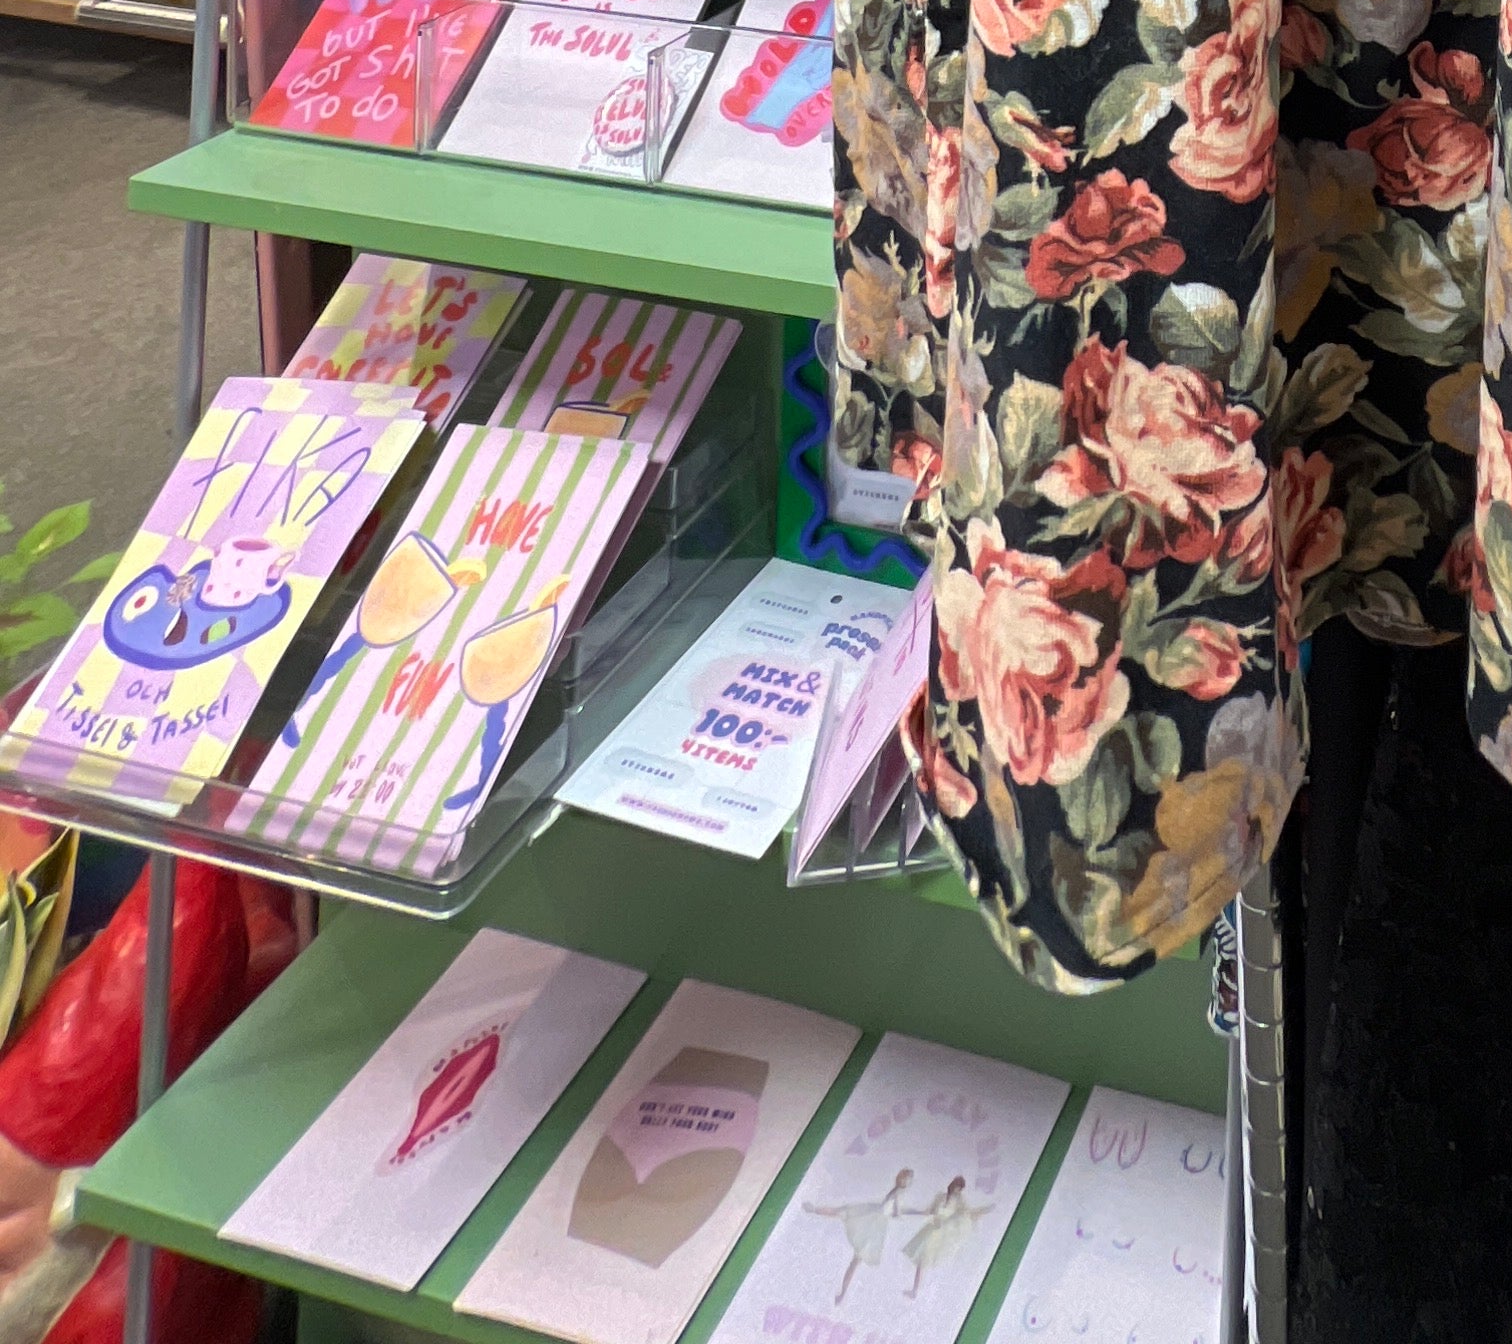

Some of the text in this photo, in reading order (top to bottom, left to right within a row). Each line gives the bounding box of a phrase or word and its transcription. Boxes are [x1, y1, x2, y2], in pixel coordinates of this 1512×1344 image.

[286, 55, 352, 100] GOT
[294, 91, 341, 124] TO
[185, 406, 372, 539] FIKA
[465, 496, 555, 554] HAVE
[382, 651, 456, 722] FUN
[722, 681, 812, 717] MATCH
[740, 661, 822, 696] MIX &
